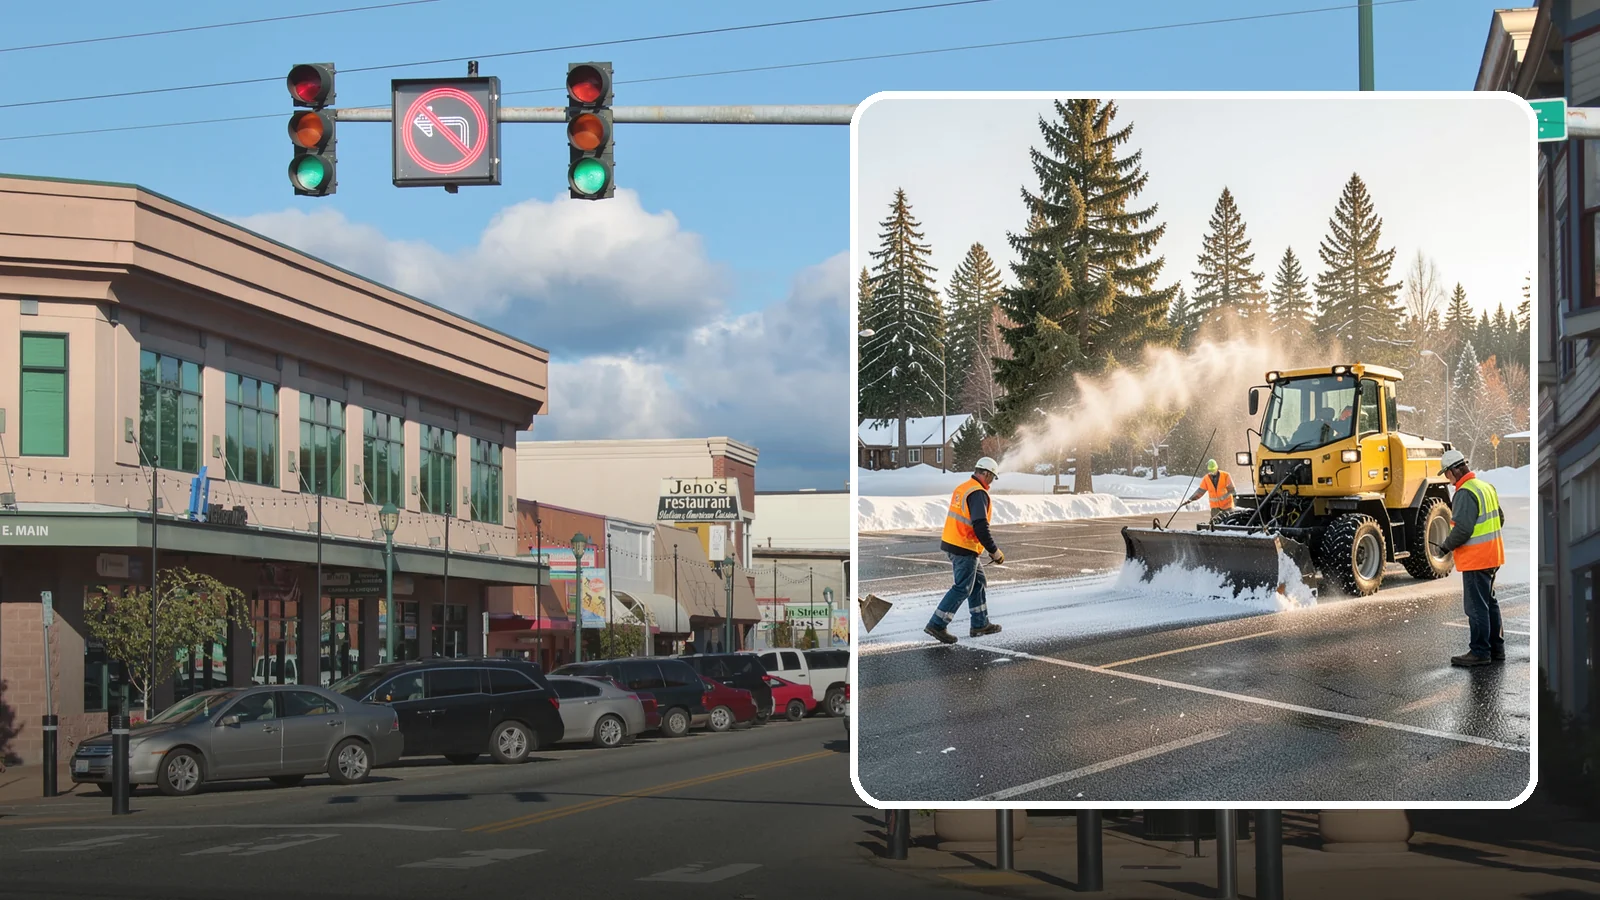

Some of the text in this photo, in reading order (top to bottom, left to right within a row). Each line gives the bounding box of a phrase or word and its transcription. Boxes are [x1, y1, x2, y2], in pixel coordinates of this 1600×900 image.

[670, 480, 727, 494] Jeno's
[665, 496, 731, 508] restaurant
[658, 509, 681, 519] Italian
[685, 509, 715, 519] American
[714, 509, 738, 519] Cuisine
[2, 525, 49, 536] E. MAIN
[797, 607, 828, 616] Street
